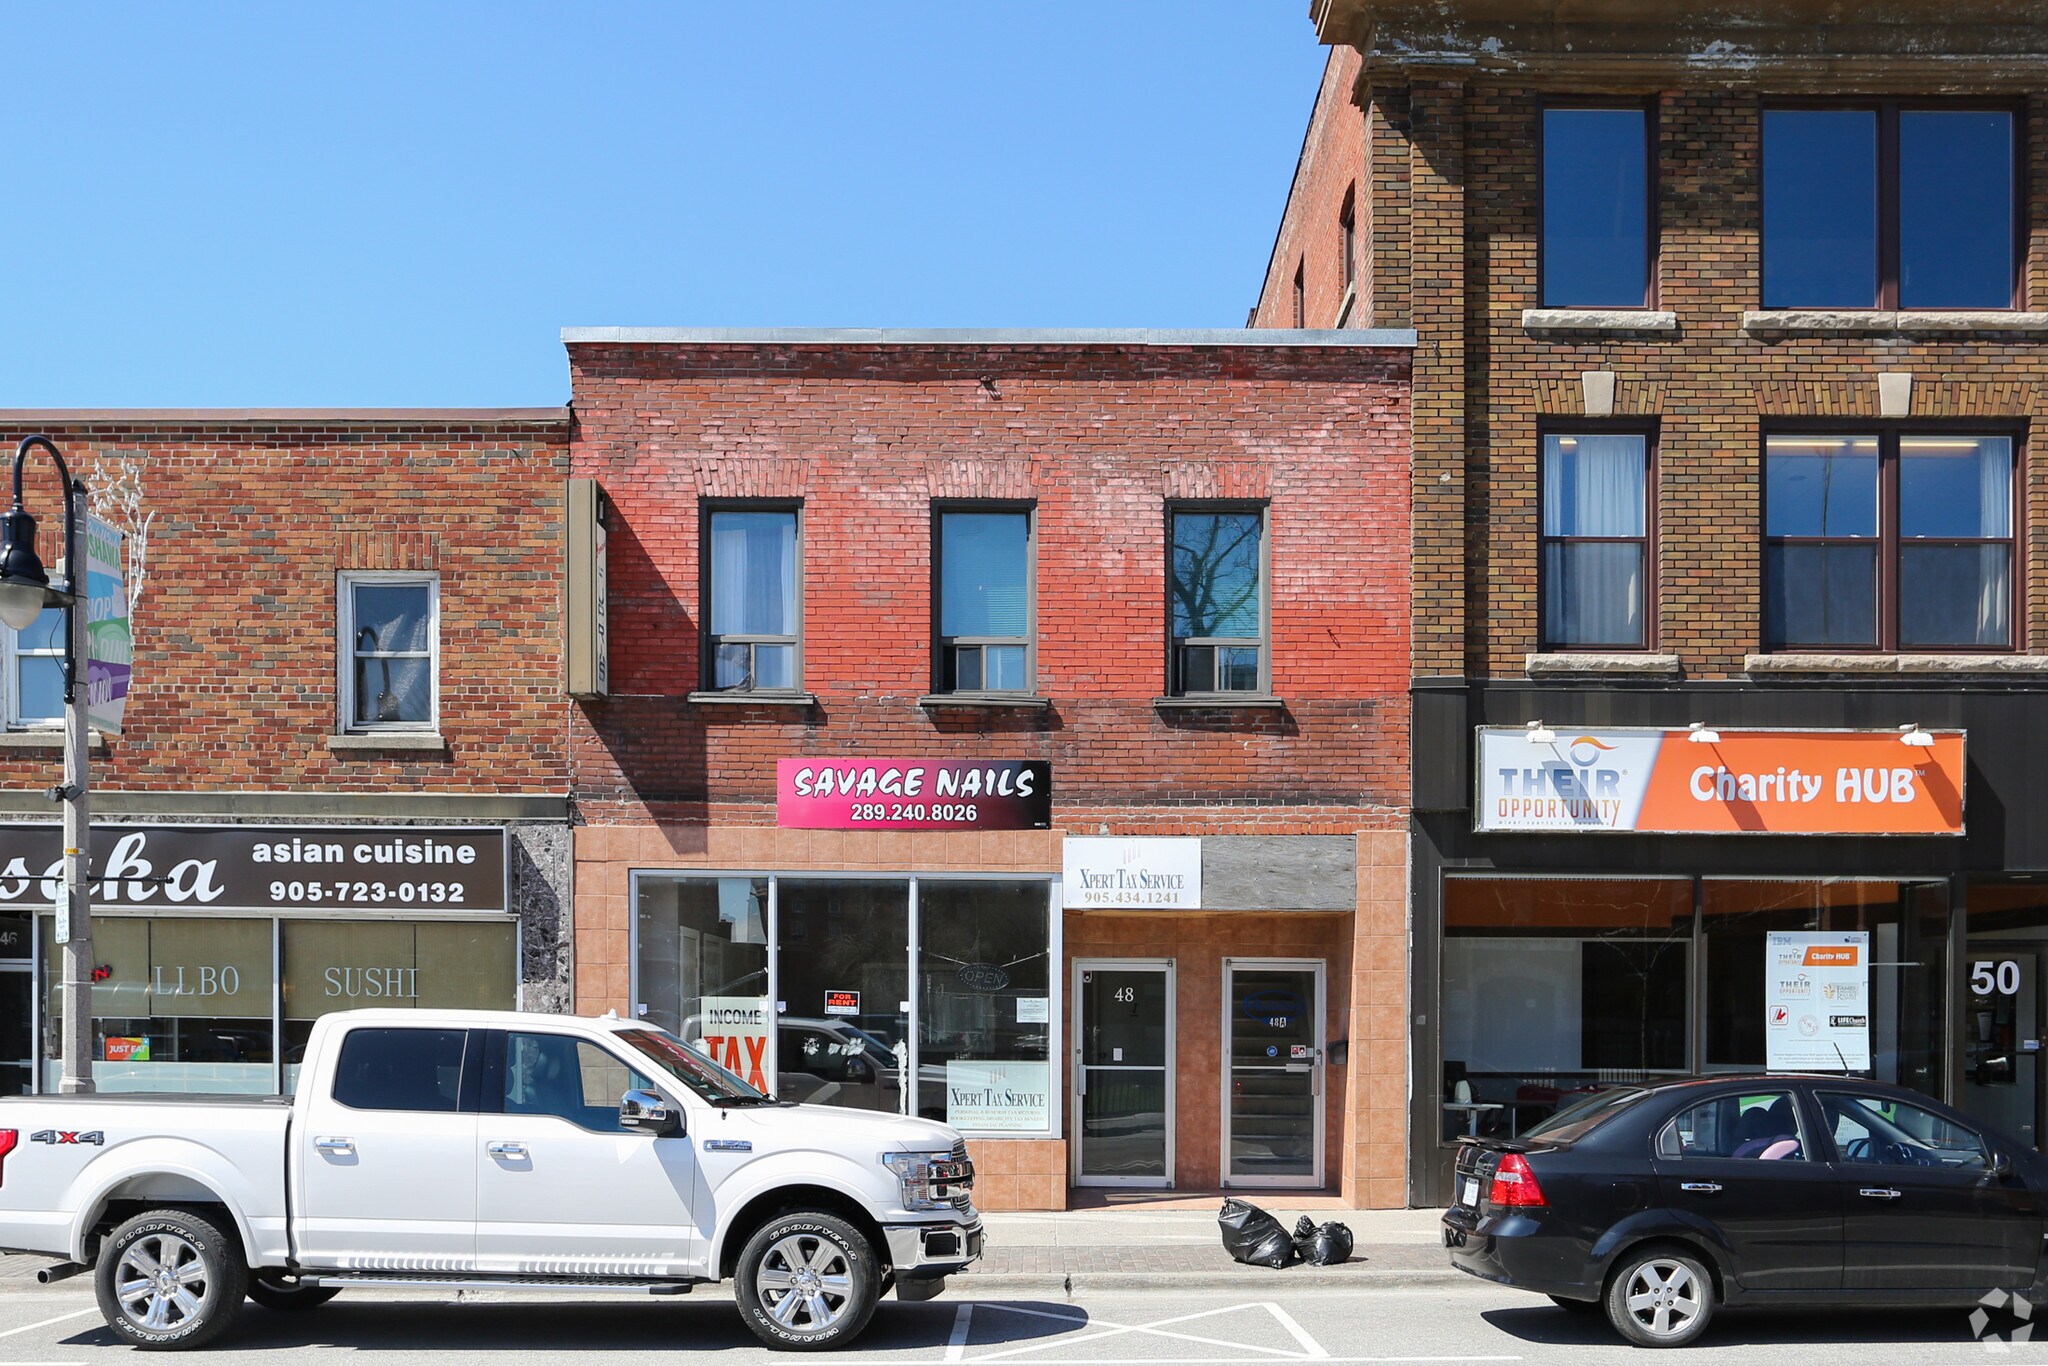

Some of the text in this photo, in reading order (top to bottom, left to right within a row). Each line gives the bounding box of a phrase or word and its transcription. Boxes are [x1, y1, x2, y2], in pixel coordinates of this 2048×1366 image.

[87, 518, 121, 546] OWNTOWN
[87, 533, 122, 573] SHAWA
[87, 596, 112, 625] HOP
[794, 766, 1034, 798] SAVAGE NAILS
[1498, 768, 1620, 796] THEIR
[1690, 765, 1822, 803] Charity
[1836, 767, 1916, 803] HUB
[850, 803, 978, 822] 289.240.8026
[1498, 798, 1622, 827] OPPORTUNITY
[252, 838, 476, 864] asian cuisine
[269, 881, 464, 903] 905-723-0132
[1085, 891, 1179, 904] 905.434.1241
[1772, 936, 1792, 946] IBM
[1811, 953, 1834, 961] Charity
[154, 966, 420, 998] LLBO SUSHI
[964, 970, 1004, 984] OPEN
[1971, 961, 2020, 995] 50
[1114, 987, 1134, 1002] 48
[709, 1009, 762, 1025] INCOME
[109, 1045, 145, 1054] JUST EAT
[704, 1036, 768, 1094] TAX
[116, 1316, 204, 1342] WRANGLER
[753, 1307, 839, 1342] WRANGLER
